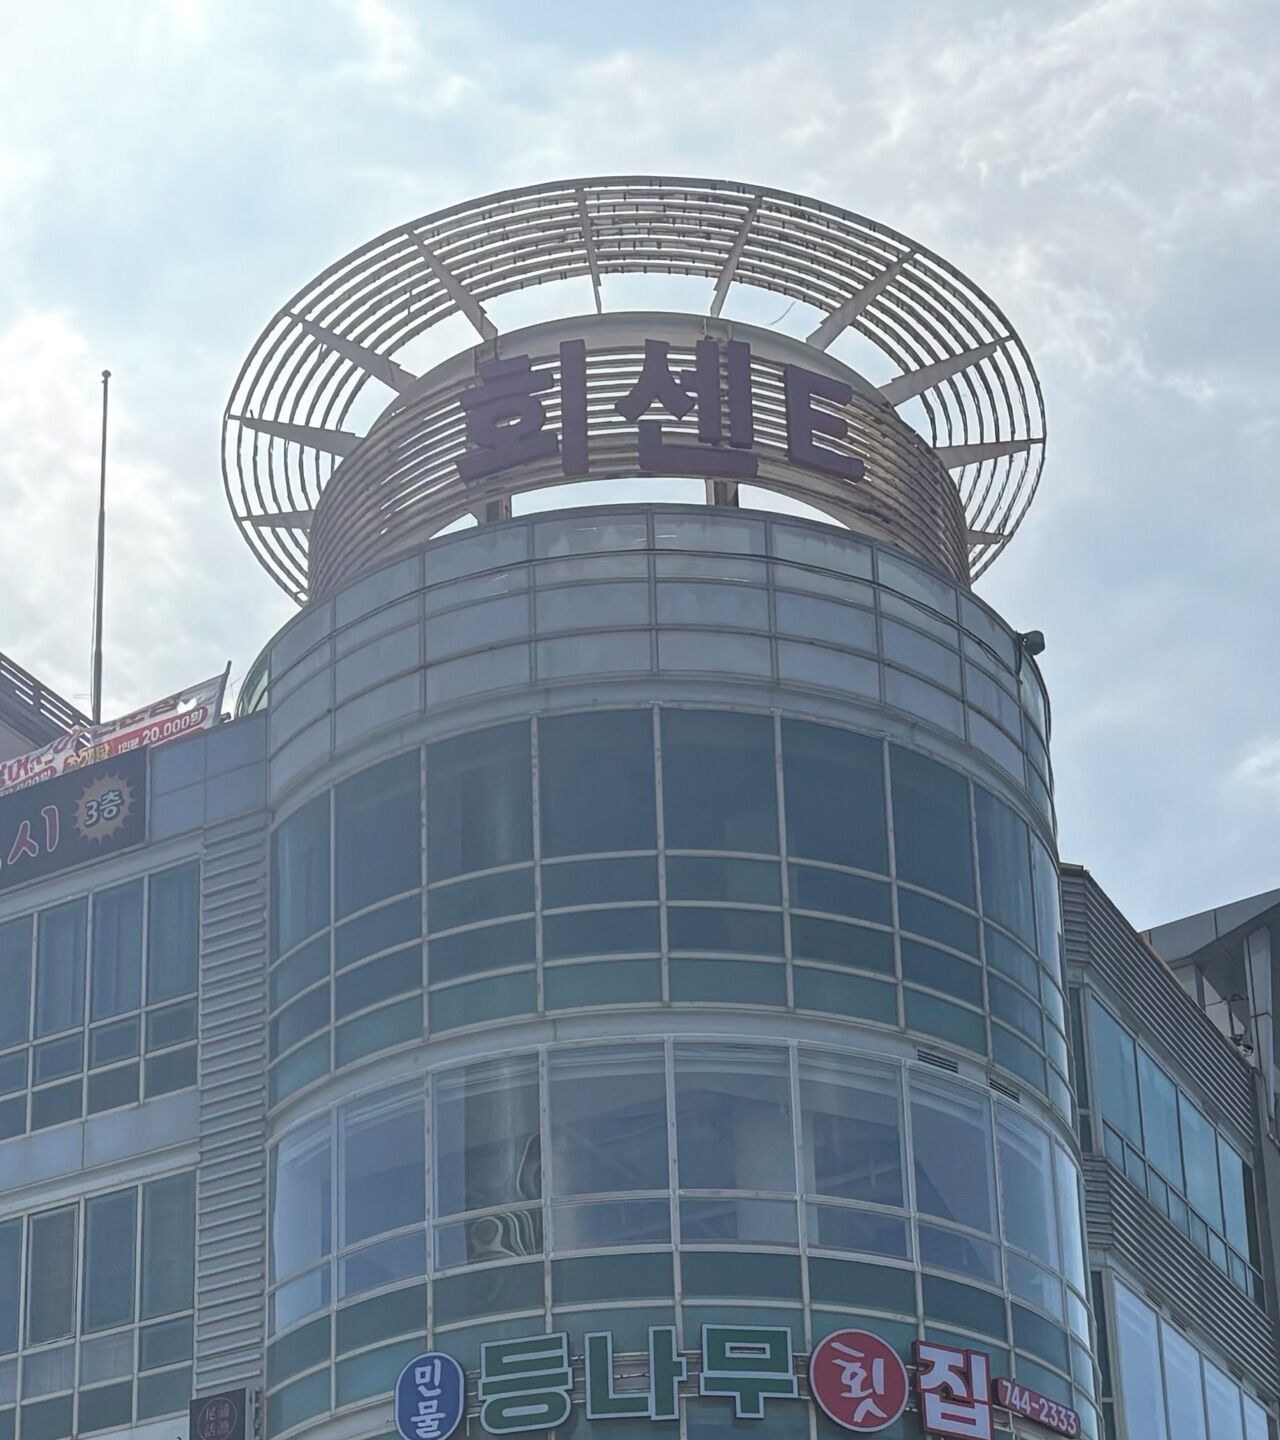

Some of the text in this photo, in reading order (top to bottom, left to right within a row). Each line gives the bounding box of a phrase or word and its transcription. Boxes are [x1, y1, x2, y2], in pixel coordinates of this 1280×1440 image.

[84, 787, 124, 825] 3층
[411, 1362, 444, 1438] 민물
[1000, 1379, 1079, 1437] 744-2333
